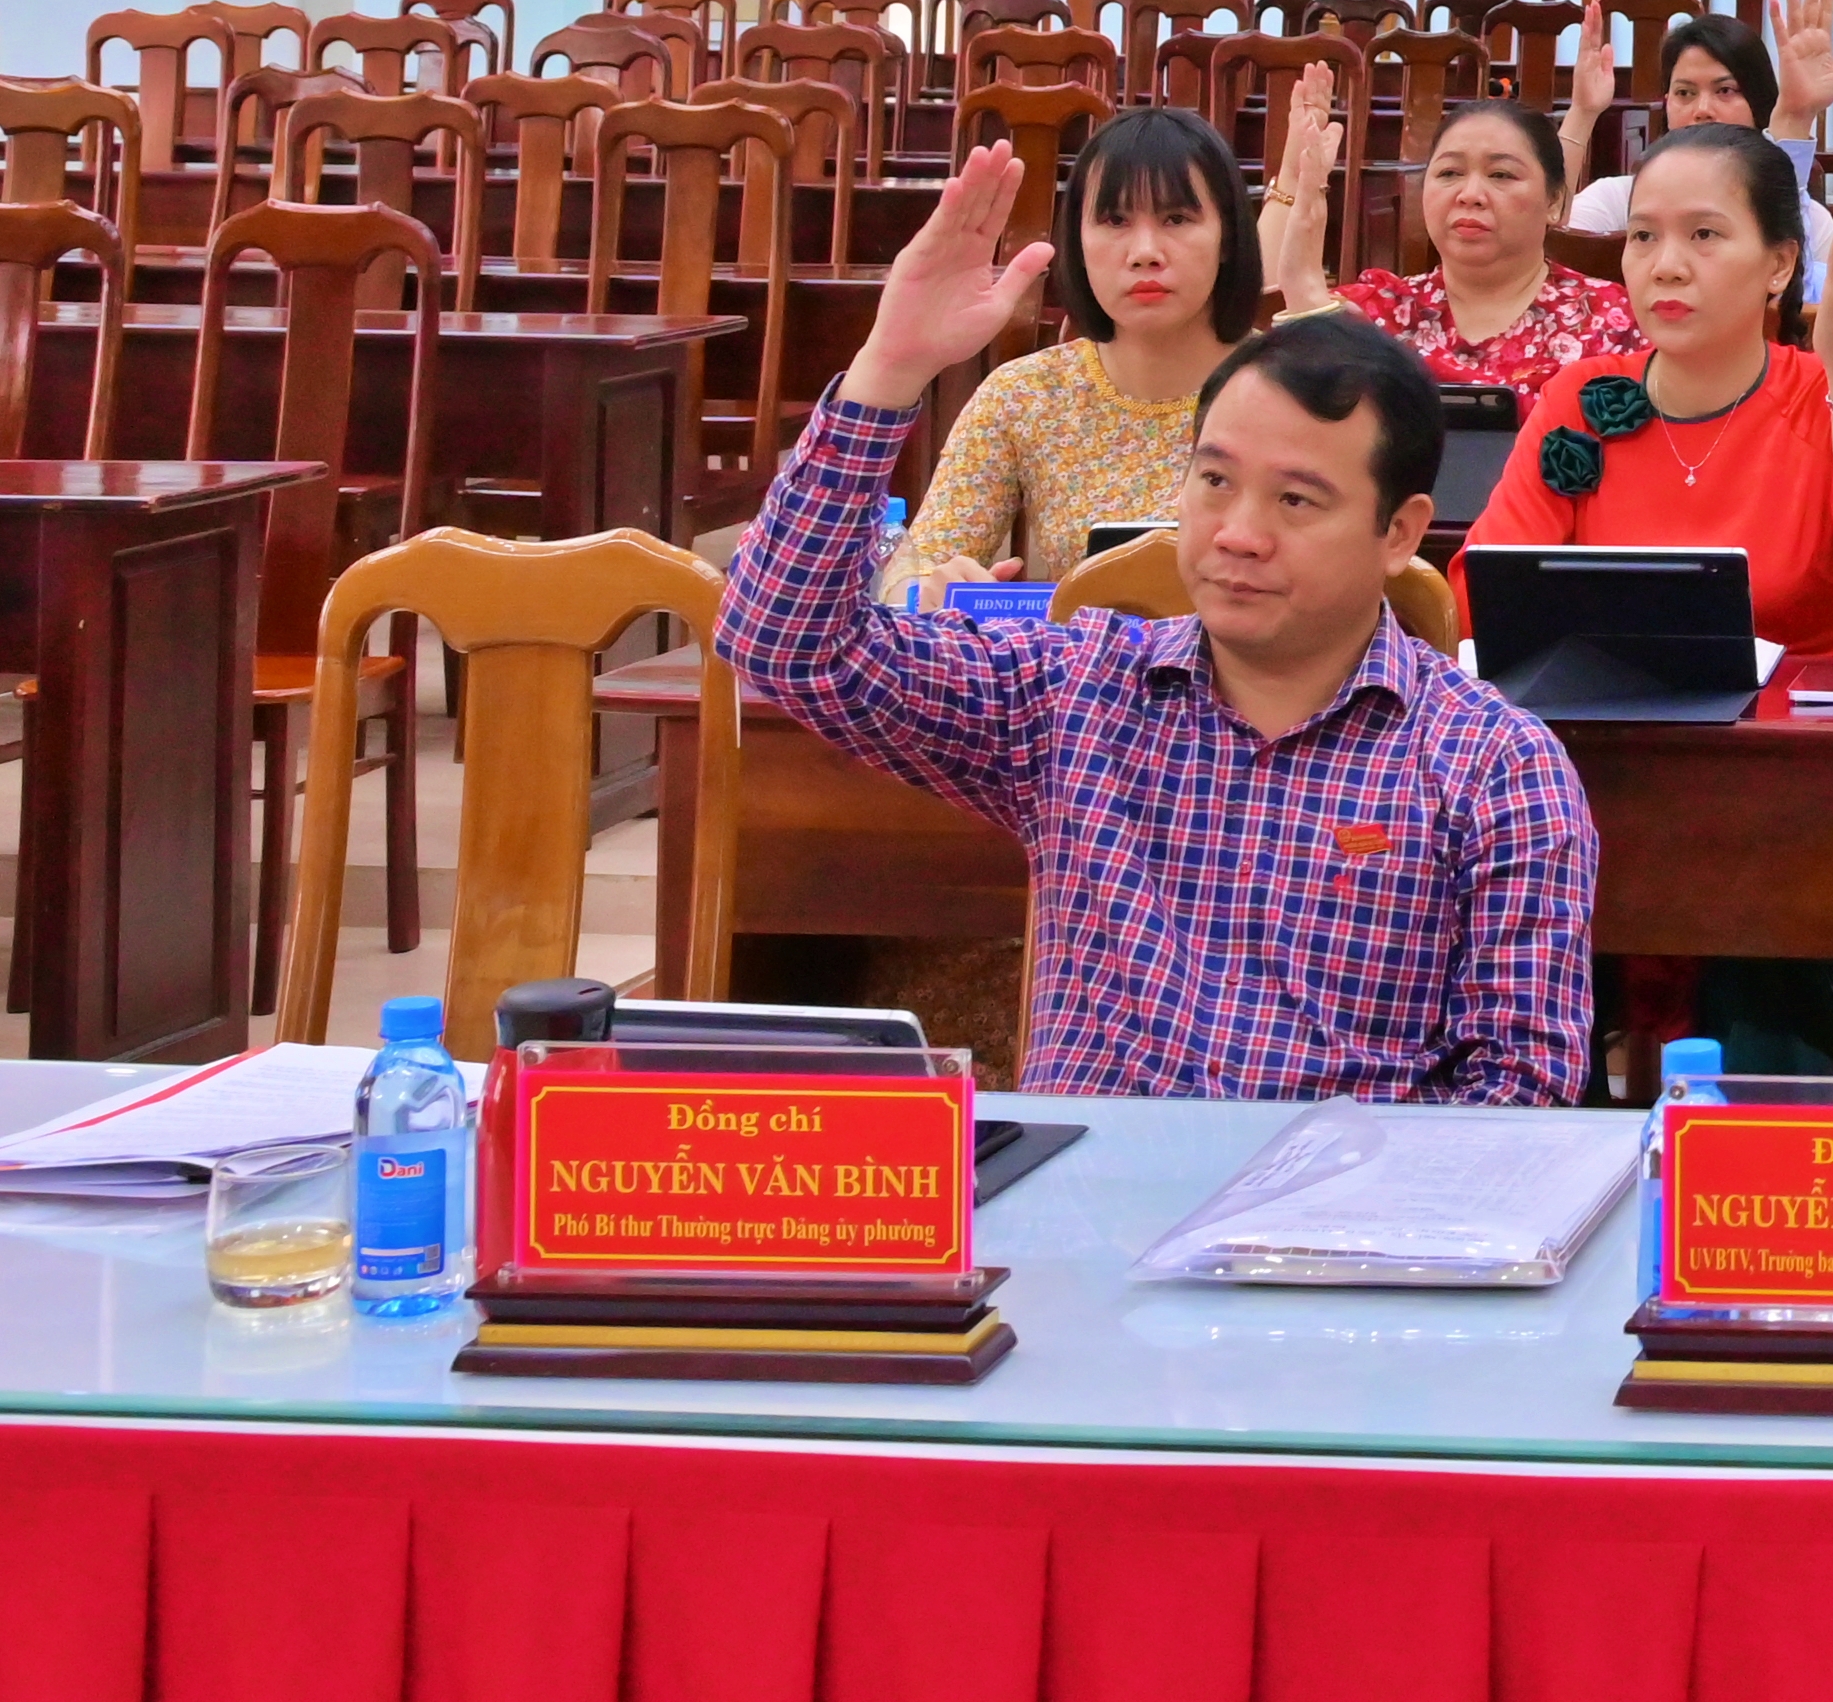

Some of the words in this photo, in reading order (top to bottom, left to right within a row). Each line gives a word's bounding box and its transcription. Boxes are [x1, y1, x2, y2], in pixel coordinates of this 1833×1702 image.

[973, 598, 1014, 611] HĐND
[667, 1099, 759, 1137] Đồng
[769, 1106, 823, 1133] chí
[378, 1157, 424, 1179] Dani
[549, 1143, 726, 1195] NGUYỄN
[736, 1155, 821, 1196] VĂN
[834, 1157, 940, 1198] BÌNH
[553, 1213, 590, 1236] Phó
[595, 1213, 616, 1236] Bí
[620, 1214, 653, 1237] thư
[657, 1214, 732, 1245] Thường
[737, 1218, 775, 1245] trực
[782, 1216, 830, 1246] Đảng
[836, 1217, 858, 1246] ủy
[864, 1218, 936, 1247] phường
[1689, 1248, 1754, 1275] UVBTV,
[1758, 1249, 1814, 1279] Trưởng
